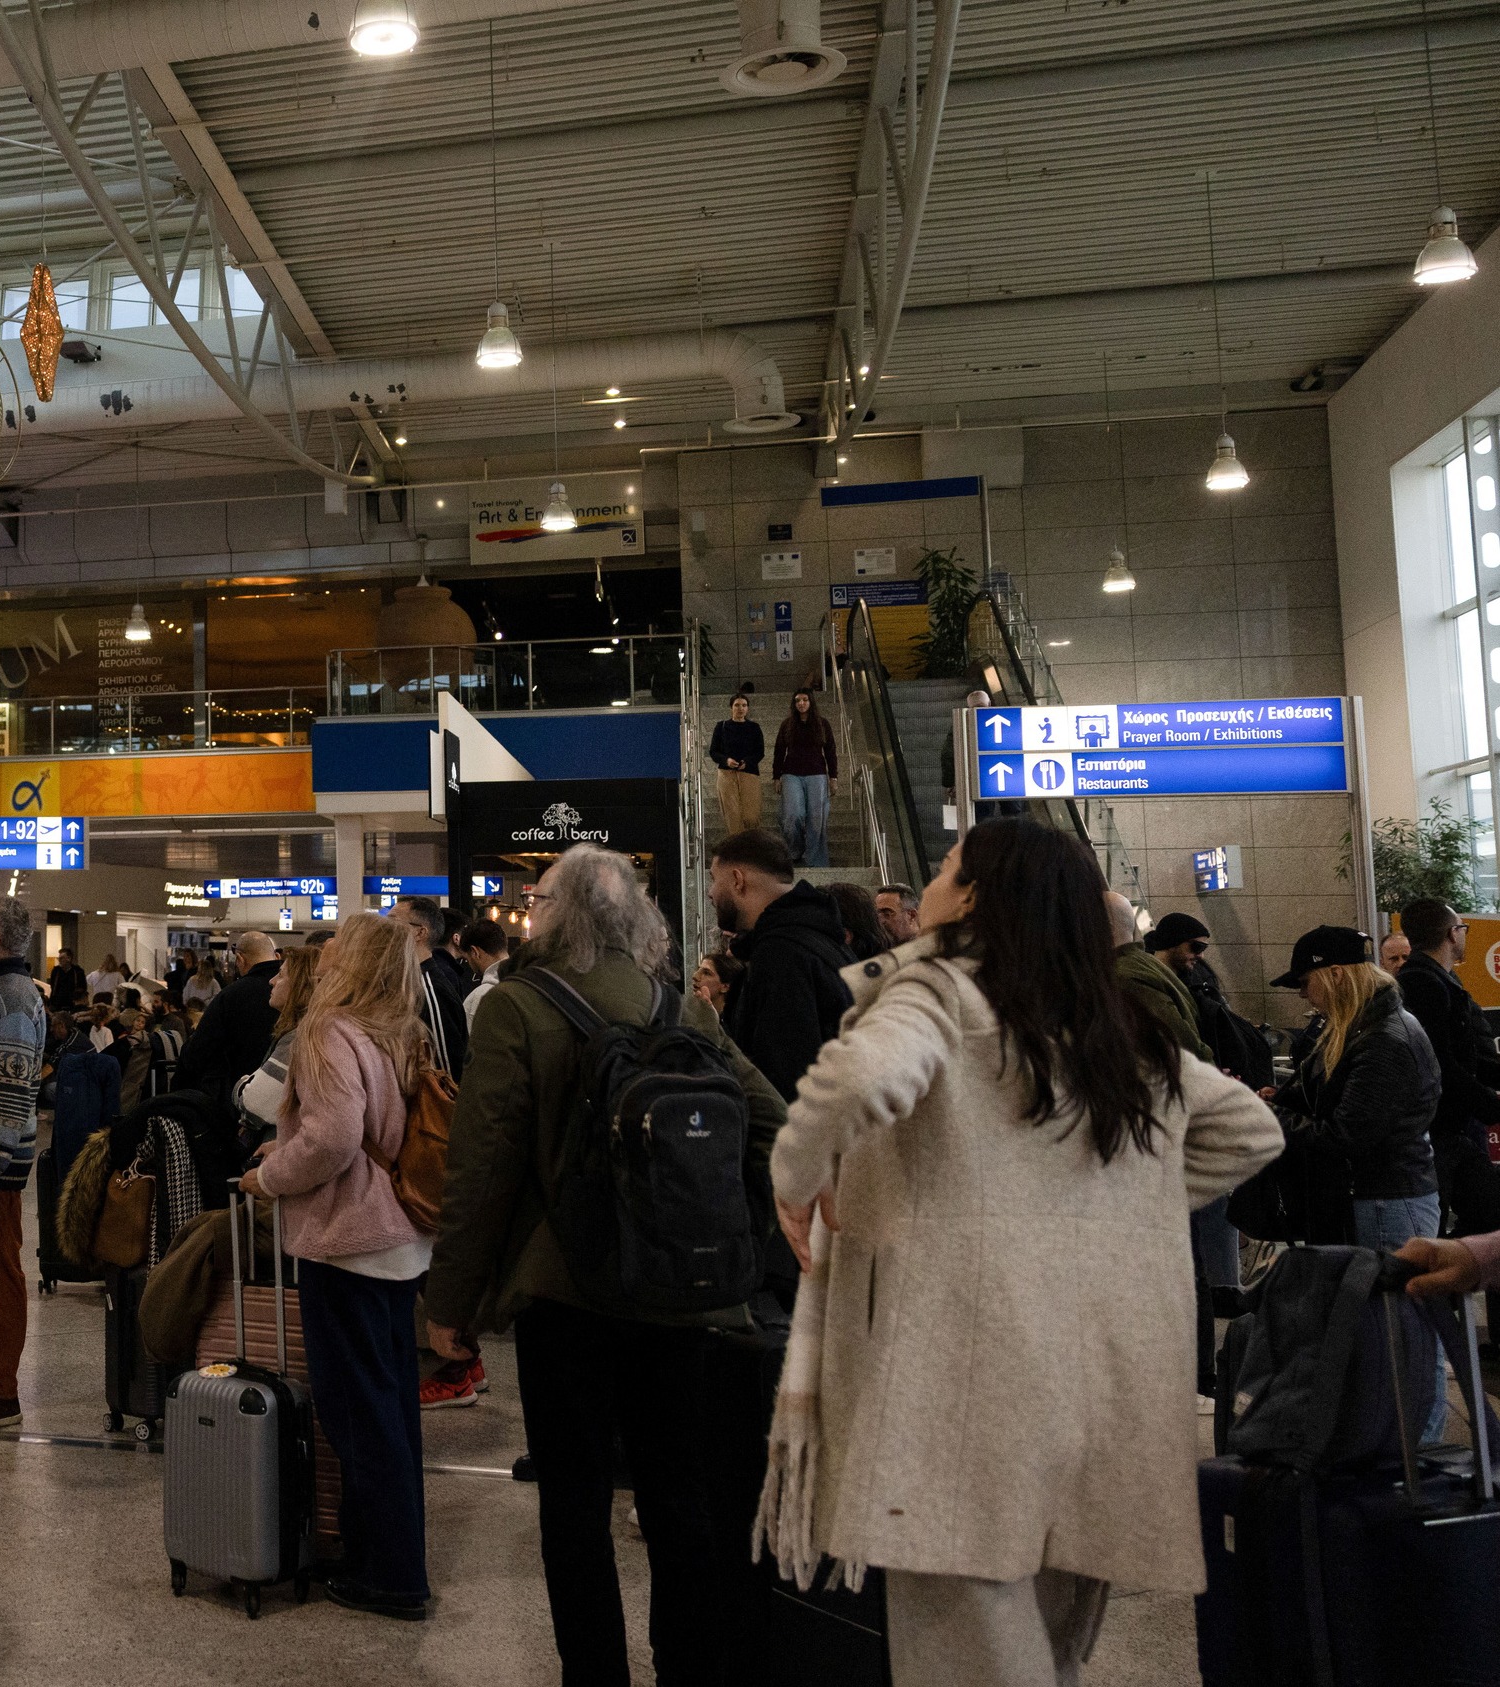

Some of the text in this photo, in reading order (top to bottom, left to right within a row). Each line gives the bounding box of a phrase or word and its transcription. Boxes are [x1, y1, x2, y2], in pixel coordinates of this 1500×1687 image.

[479, 502, 628, 525] Art & Ennment
[98, 648, 142, 658] ΠΕΡΙΟΧΗΣ
[98, 657, 164, 668] ΑΕΡΟΔΡΟΜΙΟΥ
[98, 674, 162, 686] EXHIBITION OF
[98, 684, 178, 696] ARCHAEOLOGICAL
[98, 708, 124, 716] FROM
[1124, 710, 1168, 727] Χώρος
[1176, 706, 1254, 724] Προσευχής
[1268, 706, 1332, 722] Εκθέσεις
[140, 716, 162, 724] AREA
[1124, 731, 1160, 747] Prayer
[1164, 730, 1200, 742] Room
[1214, 727, 1283, 740] Exhibitions
[1078, 758, 1146, 772] Εστιατόρια
[1078, 777, 1148, 790] Restaurants
[1, 820, 36, 840] 1-92
[511, 828, 609, 842] coffee berry
[240, 888, 292, 896] Non Standard Baggage
[300, 879, 324, 894] 92b
